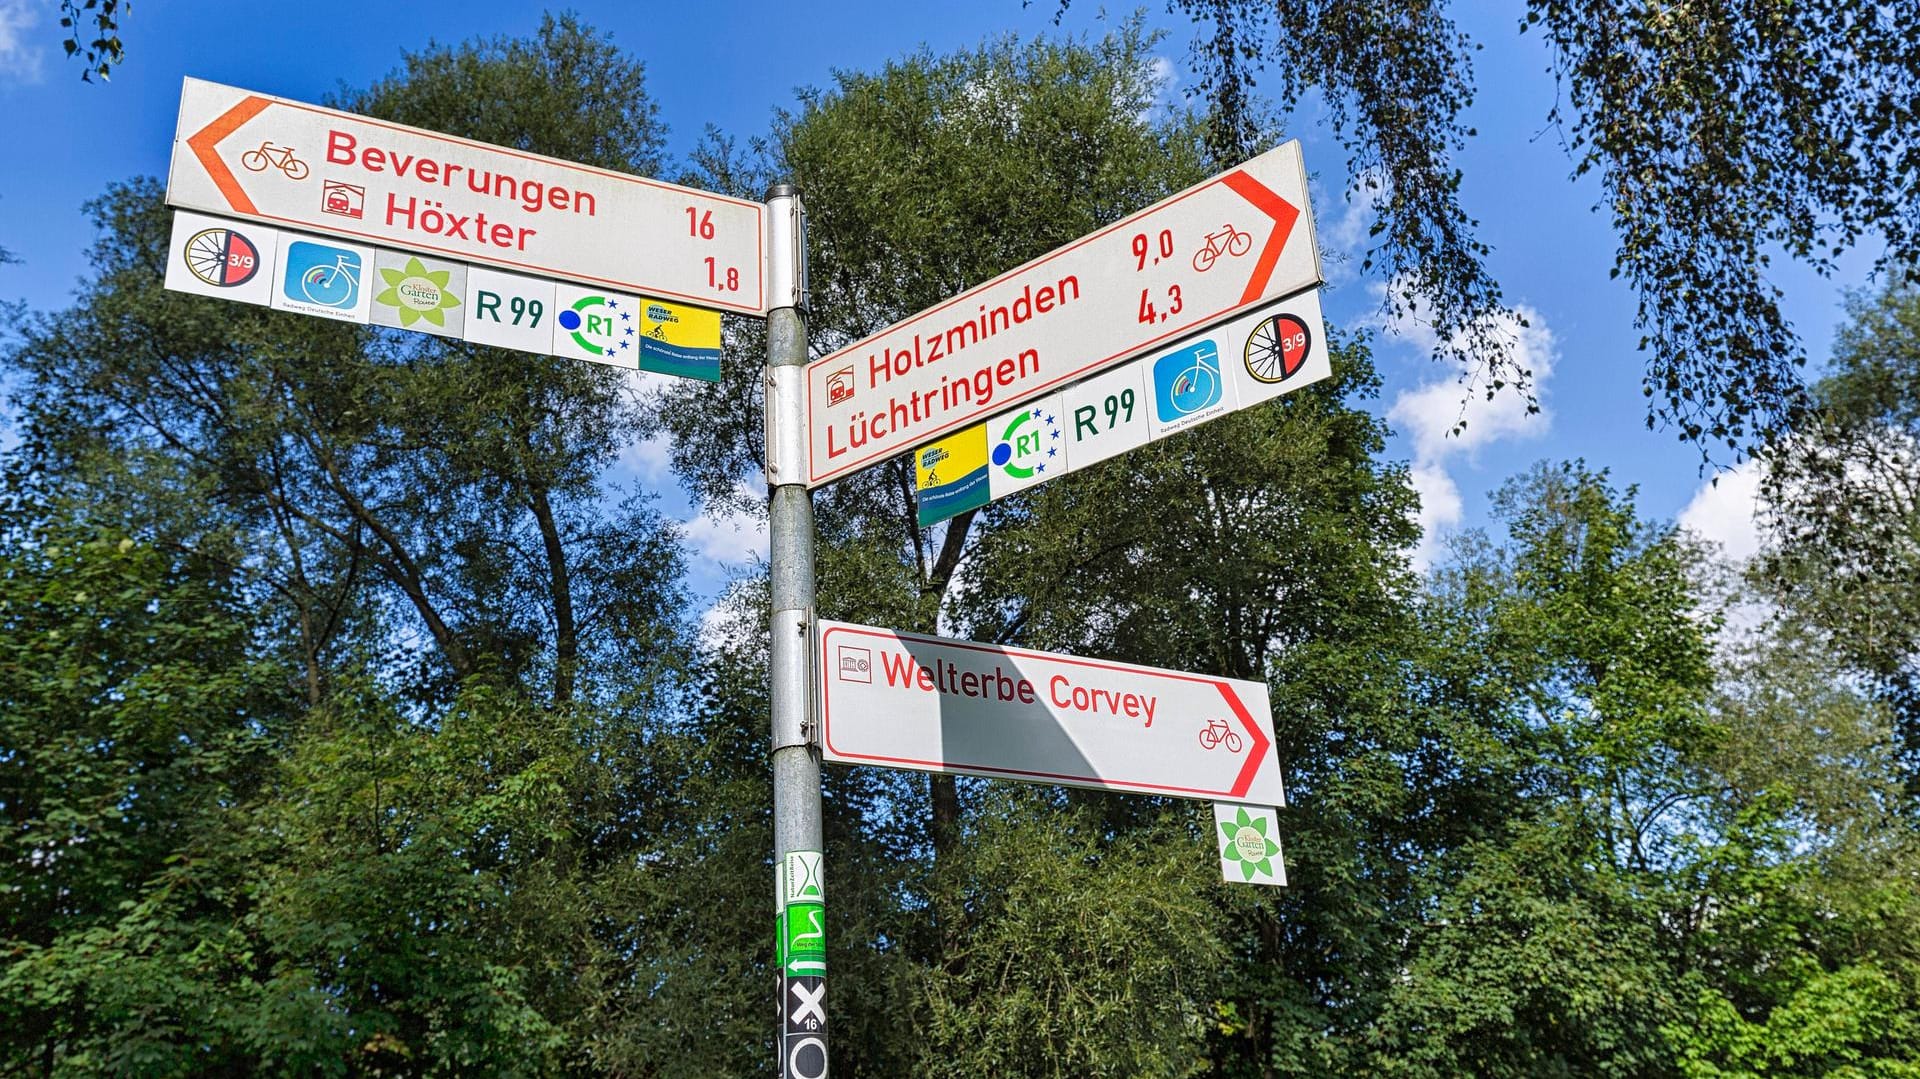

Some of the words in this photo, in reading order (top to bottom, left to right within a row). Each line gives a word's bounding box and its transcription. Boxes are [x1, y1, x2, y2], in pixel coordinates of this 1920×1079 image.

[326, 130, 596, 216] Beverungen
[685, 206, 715, 240] 16
[385, 192, 537, 251] Höxter
[704, 256, 739, 292] 1,8
[228, 253, 255, 269] 3/9
[400, 284, 439, 301] Garten
[476, 290, 501, 323] R
[510, 296, 543, 329] 99
[648, 306, 673, 316] WESER
[648, 313, 679, 323] RADWEG
[869, 275, 1080, 389] Holzminden
[1131, 229, 1174, 272] 9,0
[587, 314, 613, 337] R1
[1283, 332, 1306, 352] 3/9
[827, 348, 1040, 459] Lüchtringen
[1138, 284, 1183, 325] 4,3
[1074, 405, 1099, 442] R
[1104, 388, 1135, 430] 99
[922, 448, 943, 460] WESER
[1016, 430, 1040, 458] R1
[922, 451, 950, 468] RADWEG
[880, 650, 1035, 704] Welterbe
[1049, 674, 1157, 728] Corvey
[1236, 837, 1264, 850] Garten
[804, 1018, 818, 1030] 16
